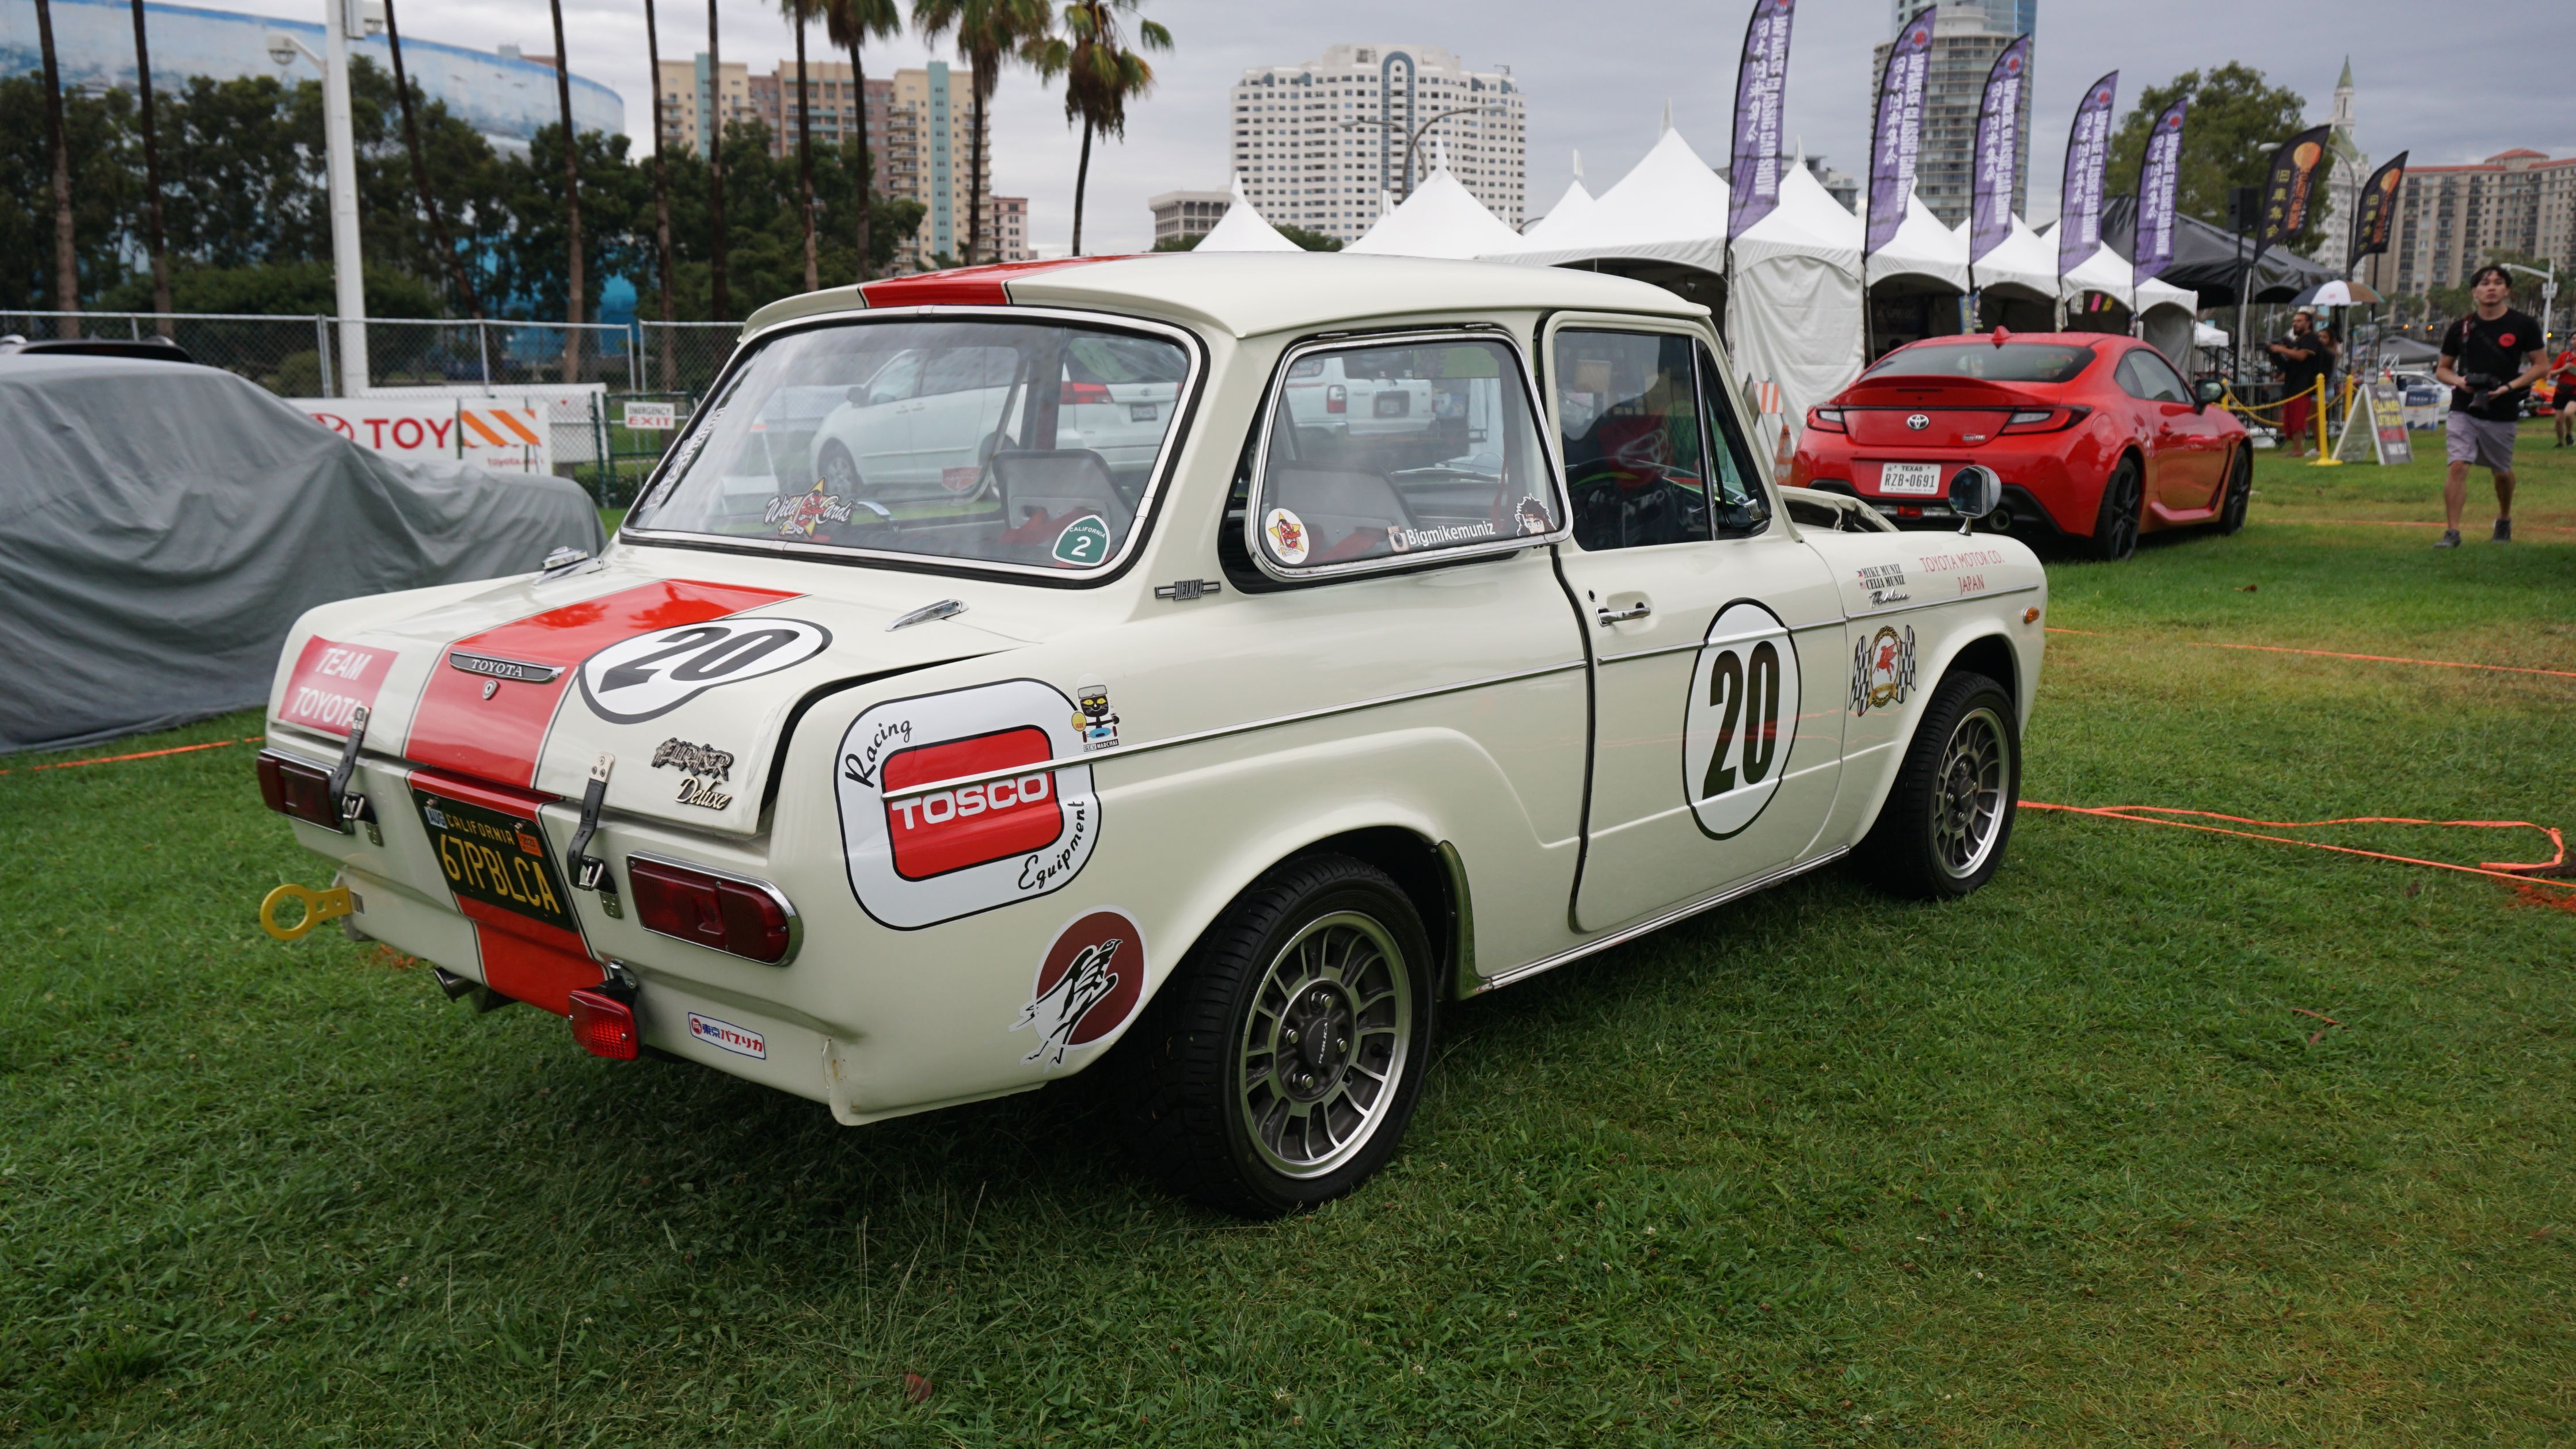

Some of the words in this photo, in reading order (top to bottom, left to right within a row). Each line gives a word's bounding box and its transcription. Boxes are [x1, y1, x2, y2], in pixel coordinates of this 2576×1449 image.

[1770, 15, 1788, 75] JAPANESE
[1905, 52, 1925, 105] JAPANESE
[1761, 77, 1782, 131] CLASSIC
[2002, 78, 2019, 126] JAPANESE
[1759, 130, 1776, 159] CAR
[1899, 106, 1920, 154] CLASSIC
[2091, 110, 2109, 154] JAPANESE
[1997, 128, 2014, 171] CLASSIC
[1755, 159, 1776, 195] SHOW
[1898, 154, 1917, 179] CAR
[2086, 155, 2103, 194] CLASSIC
[1996, 171, 2012, 194] CAR
[1995, 194, 2011, 224] SHOW
[2083, 194, 2099, 214] CAR
[2158, 210, 2172, 228] CAR
[2082, 214, 2097, 243] SHOW
[2156, 228, 2170, 255] SHOW
[627, 416, 671, 426] EXIT
[628, 405, 670, 415] EMERGENCY
[764, 494, 803, 523] Wild
[816, 495, 853, 524] Cards
[1069, 526, 1106, 539] CALIFORNIA
[1071, 536, 1091, 557] 2
[1406, 520, 1496, 547] Bigmikemuniz
[1861, 566, 1881, 578] MIKE
[1881, 564, 1902, 576] MUNIZ
[1919, 554, 1958, 573] TOYOTA
[1957, 552, 1989, 569] MOTOR
[1987, 550, 2006, 565] CO.
[1866, 577, 1885, 590] CELIA
[1886, 575, 1906, 588] MUNIZ
[1957, 574, 1985, 596] JAPAN
[315, 647, 372, 681] TEAM
[471, 658, 523, 677] TOYOTA
[598, 626, 800, 693] 20
[1702, 640, 1780, 800] 20
[845, 719, 912, 788] Racing
[1097, 739, 1118, 750] MARCHAL
[674, 776, 733, 811] Deluxe
[892, 772, 1049, 830] TOSCO
[429, 808, 446, 826] AUG
[446, 814, 515, 845] CALIFORNIA
[1017, 800, 1085, 890] Equipment
[440, 834, 561, 914] 67PBLCA
[702, 1023, 763, 1053] 東京パブリカ
